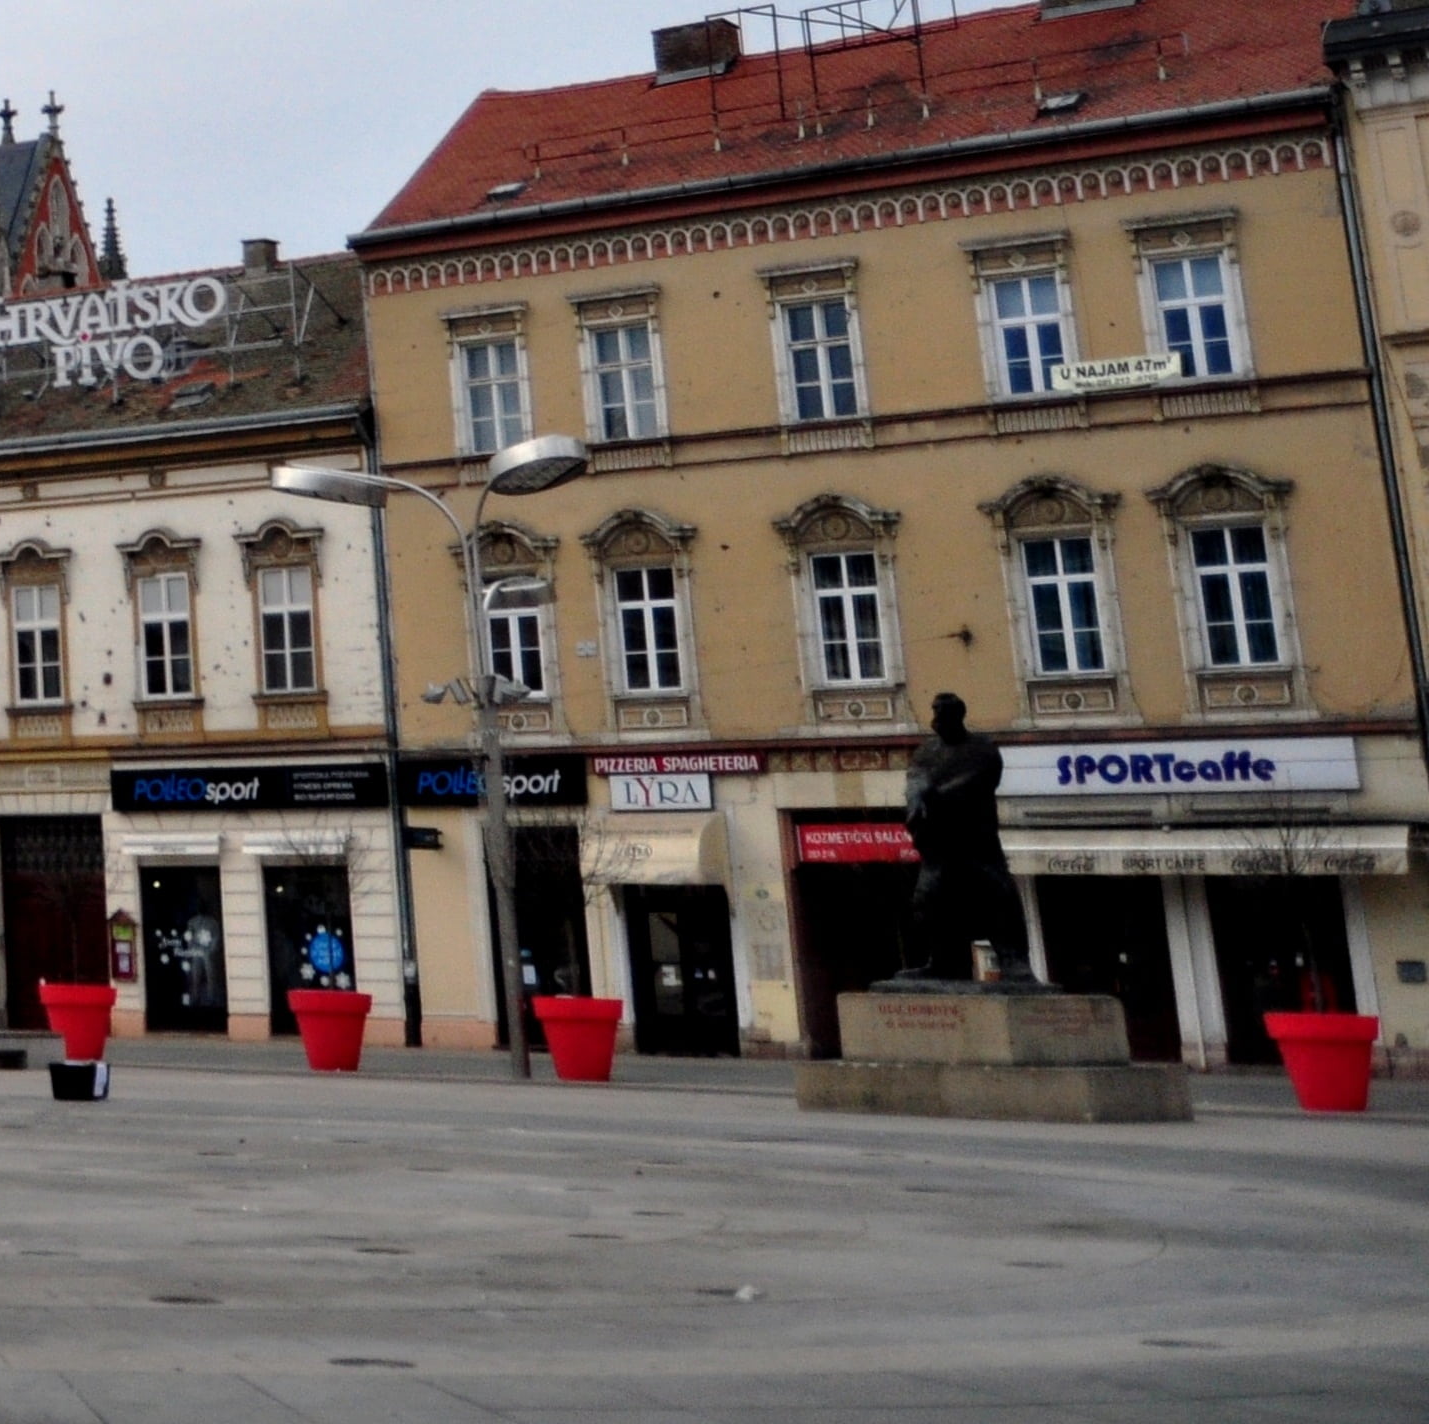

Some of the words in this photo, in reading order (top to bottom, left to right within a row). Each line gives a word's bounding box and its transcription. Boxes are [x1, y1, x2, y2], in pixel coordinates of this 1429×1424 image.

[51, 334, 164, 388] PIVO
[1061, 367, 1070, 380] U
[1076, 362, 1130, 378] NAJAM
[594, 756, 658, 774] PIZZERIA
[662, 754, 759, 772] SPAGHETERIA
[1057, 750, 1275, 786] SPORTcaffe
[625, 777, 701, 807] LYRA
[1122, 857, 1162, 871] SPORT
[1165, 855, 1205, 870] CAFFE
